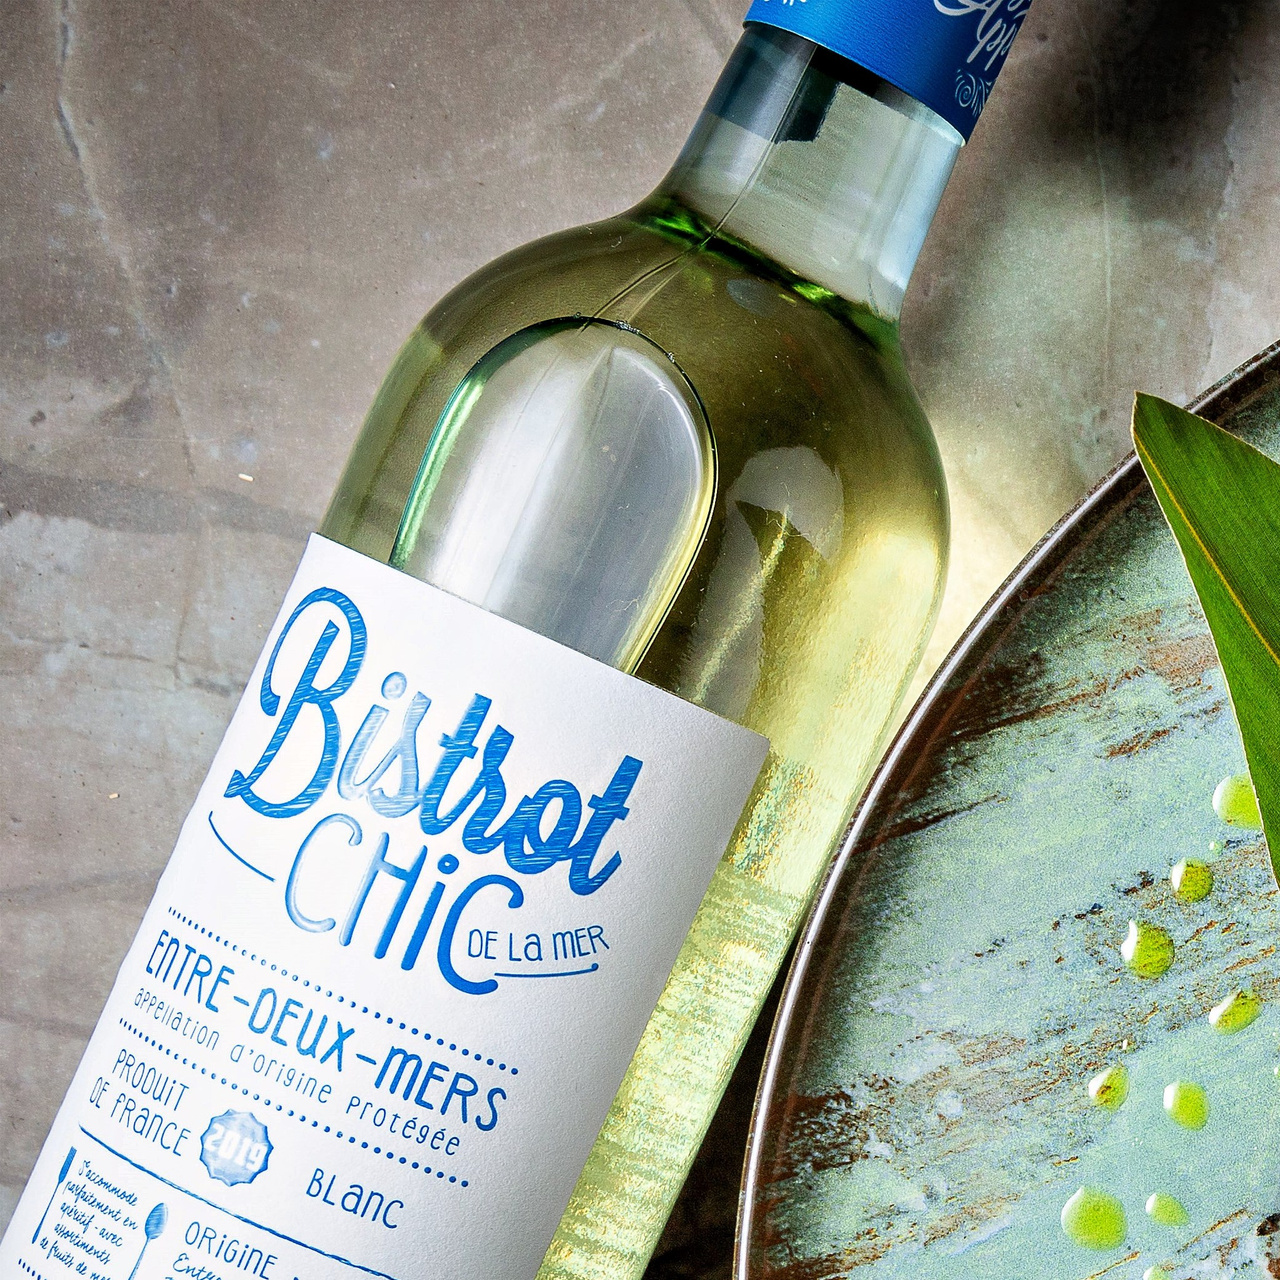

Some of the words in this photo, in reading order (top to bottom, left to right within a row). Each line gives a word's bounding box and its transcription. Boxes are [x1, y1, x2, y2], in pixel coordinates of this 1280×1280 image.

[224, 586, 643, 896] Bistrot
[468, 928, 498, 960] DE
[145, 929, 508, 1132] ENTRE-DEUX-MERS
[89, 1076, 110, 1109] DE
[112, 1048, 190, 1112] PRODUIT
[134, 988, 220, 1051] appellation
[230, 1044, 332, 1104] d'origine
[345, 1096, 460, 1156] protégée
[204, 1123, 269, 1170] 2019
[60, 1202, 95, 1234] apéritif
[99, 1227, 123, 1247] avec
[62, 1181, 121, 1221] parfaitement
[122, 1216, 138, 1230] en
[40, 1237, 49, 1249] de
[46, 1240, 74, 1268] fruits
[75, 1262, 87, 1275] de
[54, 1223, 110, 1265] assortiments
